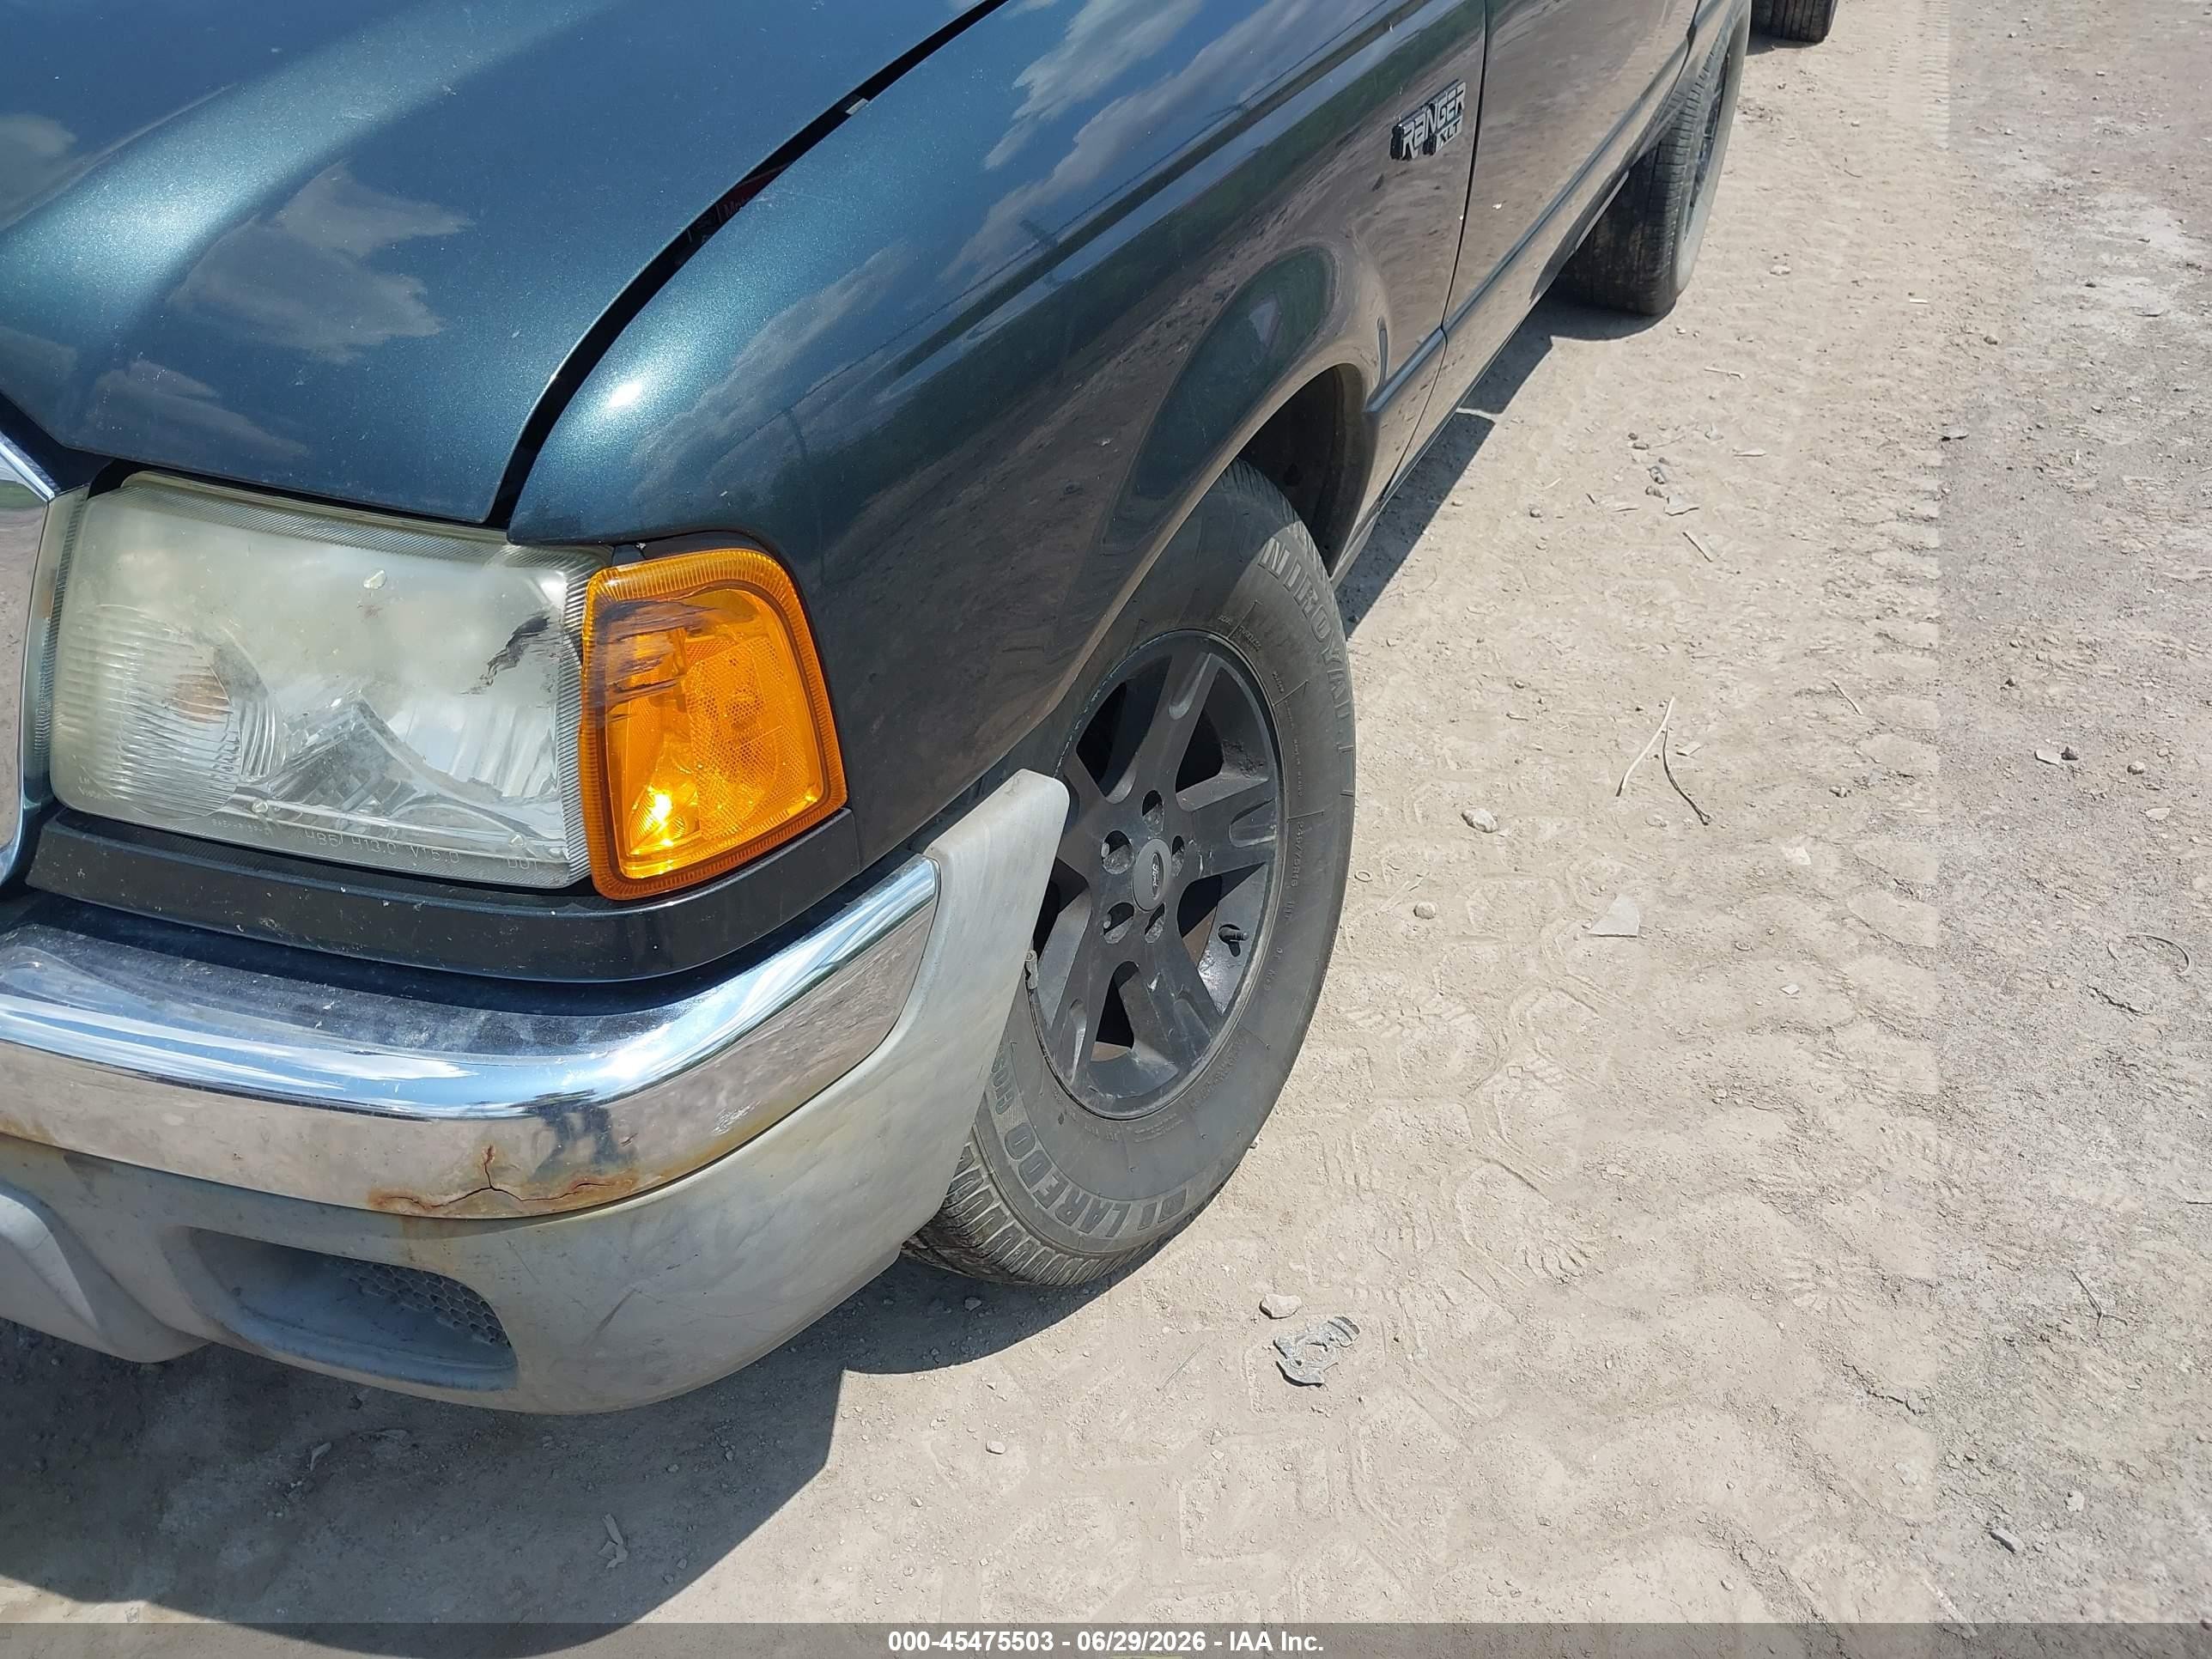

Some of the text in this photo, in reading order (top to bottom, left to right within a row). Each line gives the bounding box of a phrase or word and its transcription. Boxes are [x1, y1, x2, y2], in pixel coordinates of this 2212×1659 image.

[1401, 82, 1466, 160] RANGER
[1437, 117, 1462, 148] XLT
[1005, 1121, 1132, 1238] LAREDO
